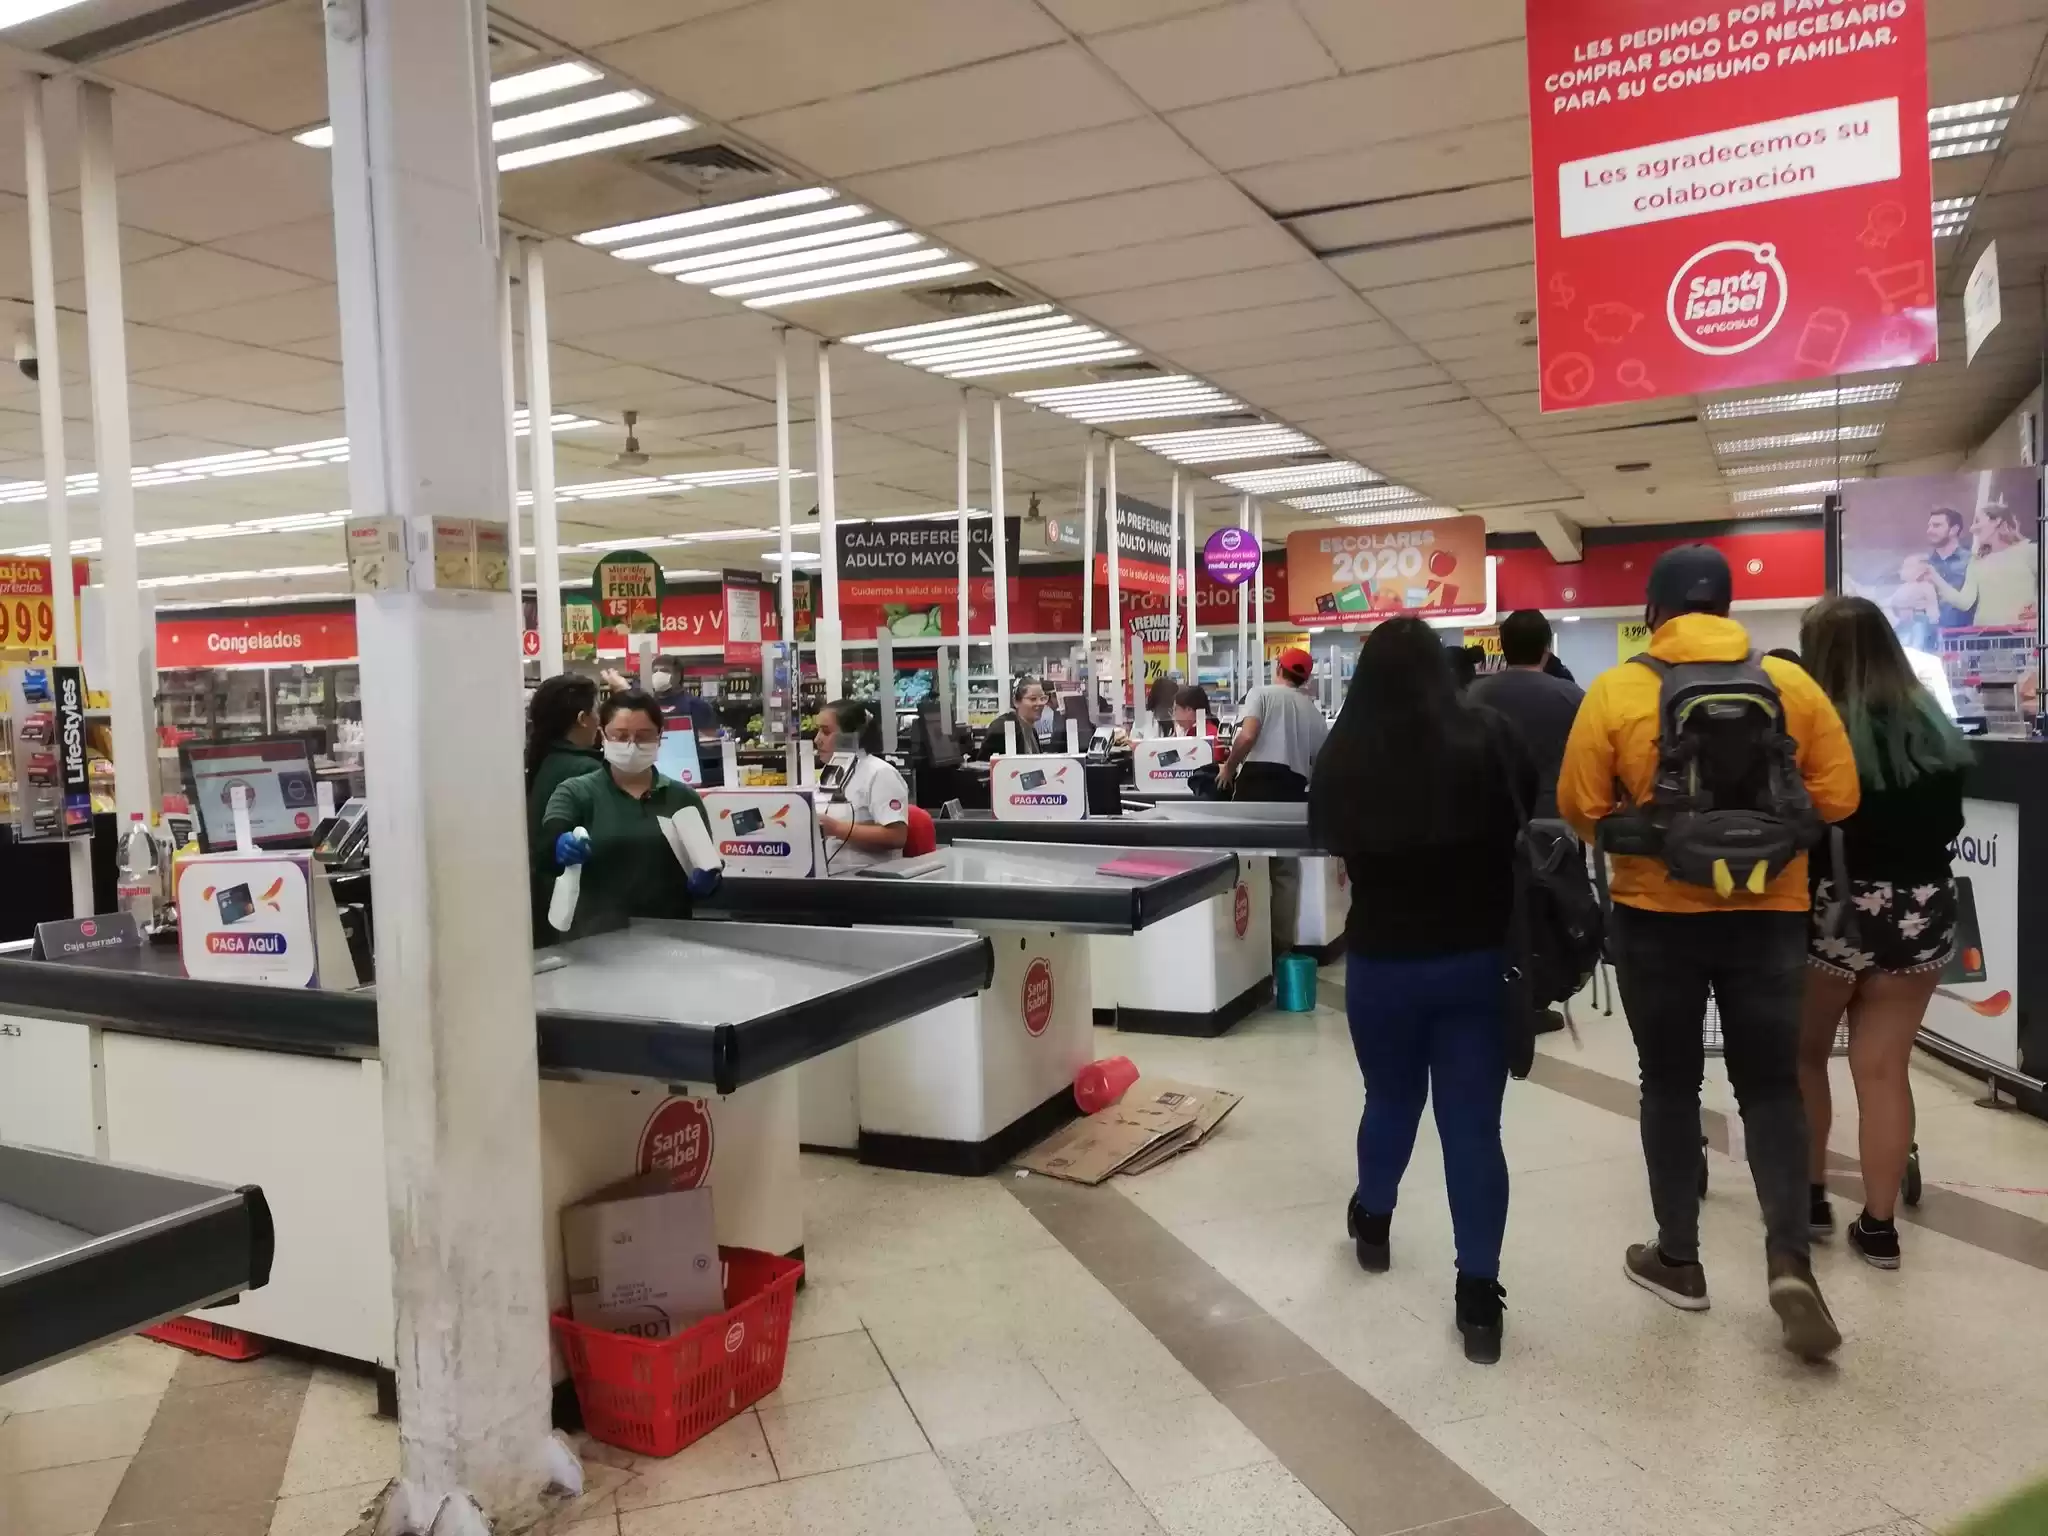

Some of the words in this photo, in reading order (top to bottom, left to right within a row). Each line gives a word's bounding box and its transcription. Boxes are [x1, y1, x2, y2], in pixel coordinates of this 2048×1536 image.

[1573, 37, 1614, 63] LES
[1619, 13, 1721, 52] PEDIMOS
[1727, 1, 1776, 28] POR
[1544, 53, 1653, 92] COMPRAR
[1658, 38, 1721, 67] SOLO
[1728, 29, 1759, 52] LO
[1766, 0, 1907, 45] NECESARIO
[1553, 86, 1612, 115] PARA
[1617, 78, 1646, 101] SU
[1652, 52, 1771, 92] CONSUMO
[1583, 166, 1627, 189] Les
[1636, 127, 1828, 181] agradecemos
[1837, 118, 1870, 138] su
[1633, 161, 1816, 212] colaboración
[1688, 268, 1767, 299] Santa
[1695, 314, 1760, 335] cencosud
[844, 532, 886, 548] CAJA
[1319, 529, 1436, 553] ESCOLARES
[844, 551, 907, 568] ADULTO
[911, 551, 960, 567] MAYO
[1331, 547, 1424, 583] 2020
[608, 582, 652, 597] FERIA
[851, 586, 894, 597] Cuidemos
[895, 585, 904, 595] la
[905, 585, 929, 595] salud
[930, 585, 942, 594] de
[609, 599, 628, 616] 15
[692, 615, 705, 635] y
[207, 630, 302, 654] Congelados
[61, 677, 85, 784] LifeStyles
[1153, 770, 1174, 779] PAGA
[1014, 796, 1038, 805] PAGA
[1039, 794, 1063, 805] AQUÍ
[725, 843, 754, 855] PAGA
[756, 841, 784, 856] AQUÍ
[1949, 833, 1998, 868] AQUÍ
[63, 942, 86, 953] Caja
[86, 936, 123, 949] cerrada
[211, 937, 245, 952] PAGA
[247, 934, 279, 953] AQUÍ
[1027, 978, 1049, 997] Santa
[652, 1122, 701, 1156] Santa
